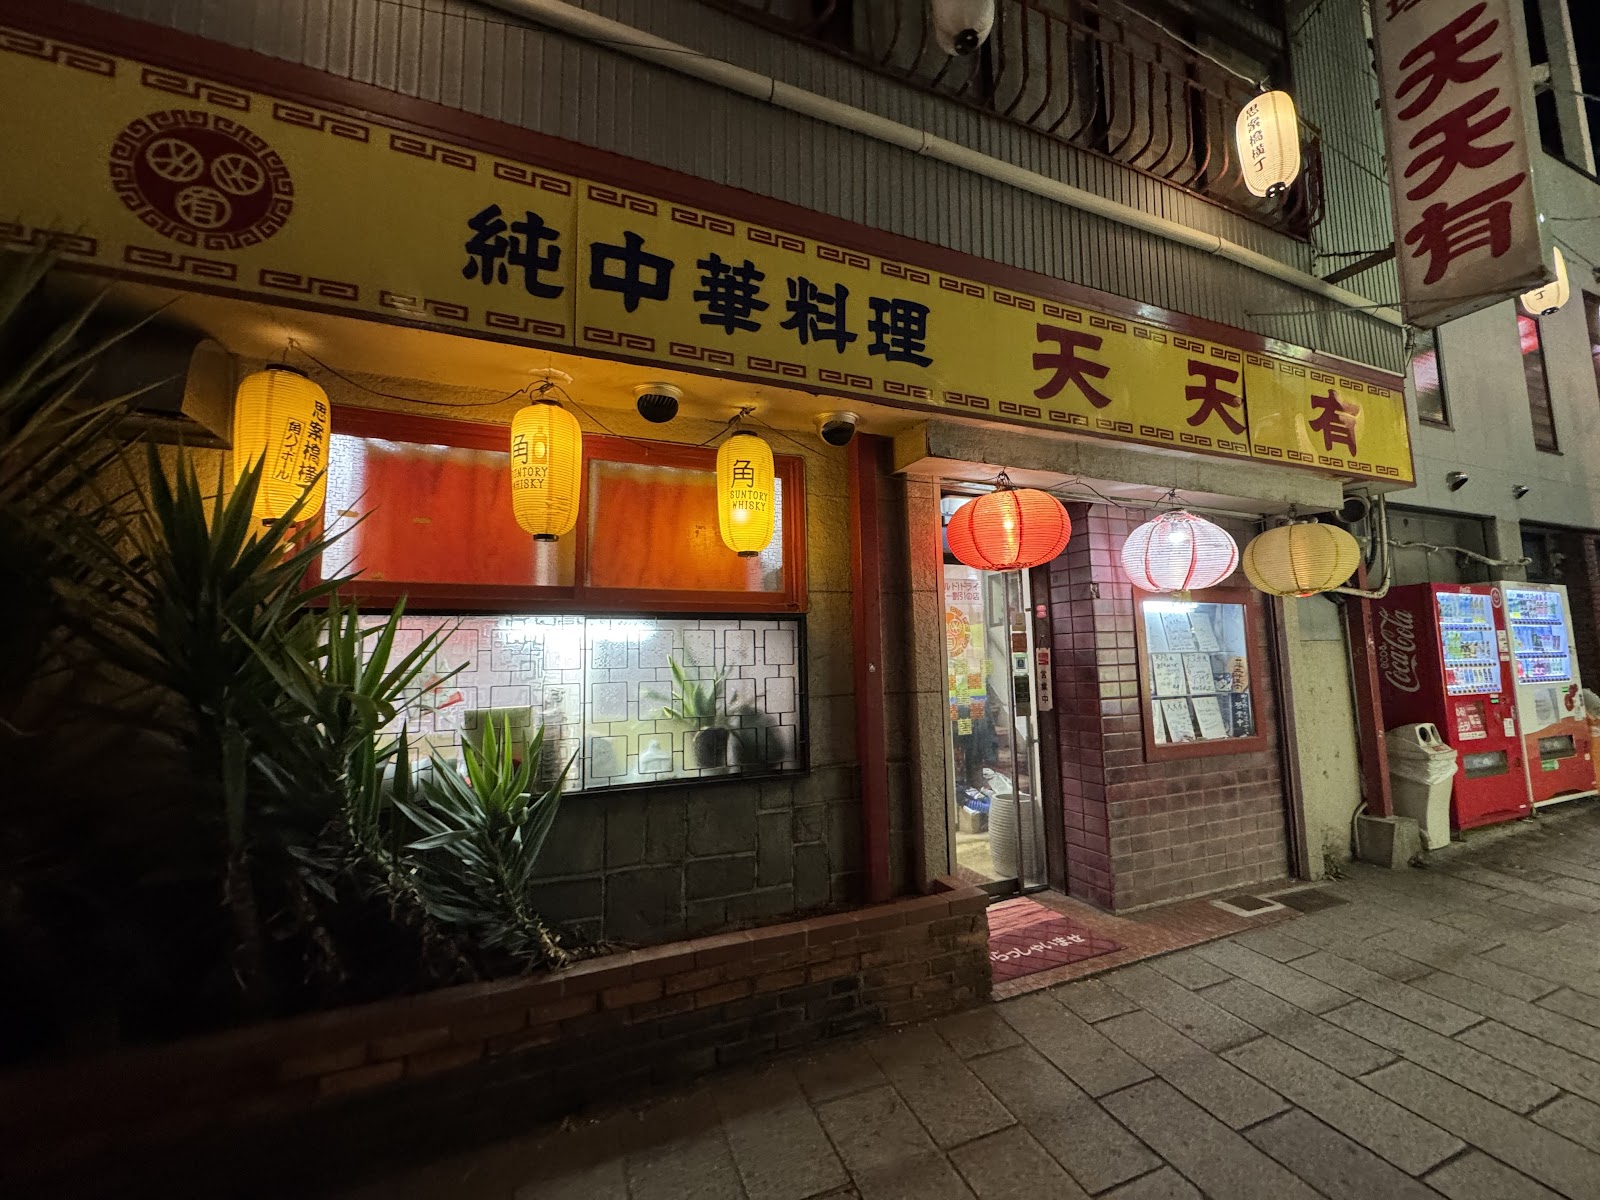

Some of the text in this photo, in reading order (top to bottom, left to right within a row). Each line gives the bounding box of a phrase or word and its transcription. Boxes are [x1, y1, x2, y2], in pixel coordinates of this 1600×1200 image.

[1395, 2, 1526, 285] 天天有
[461, 203, 1365, 458] 純中華料理 天天有
[276, 421, 302, 480] 角ハイボール
[513, 433, 528, 465] 角
[731, 459, 754, 488] 角
[730, 490, 768, 502] SUNTORY
[732, 501, 766, 512] WHISKY
[989, 933, 1086, 962] いらっしゃいませ
